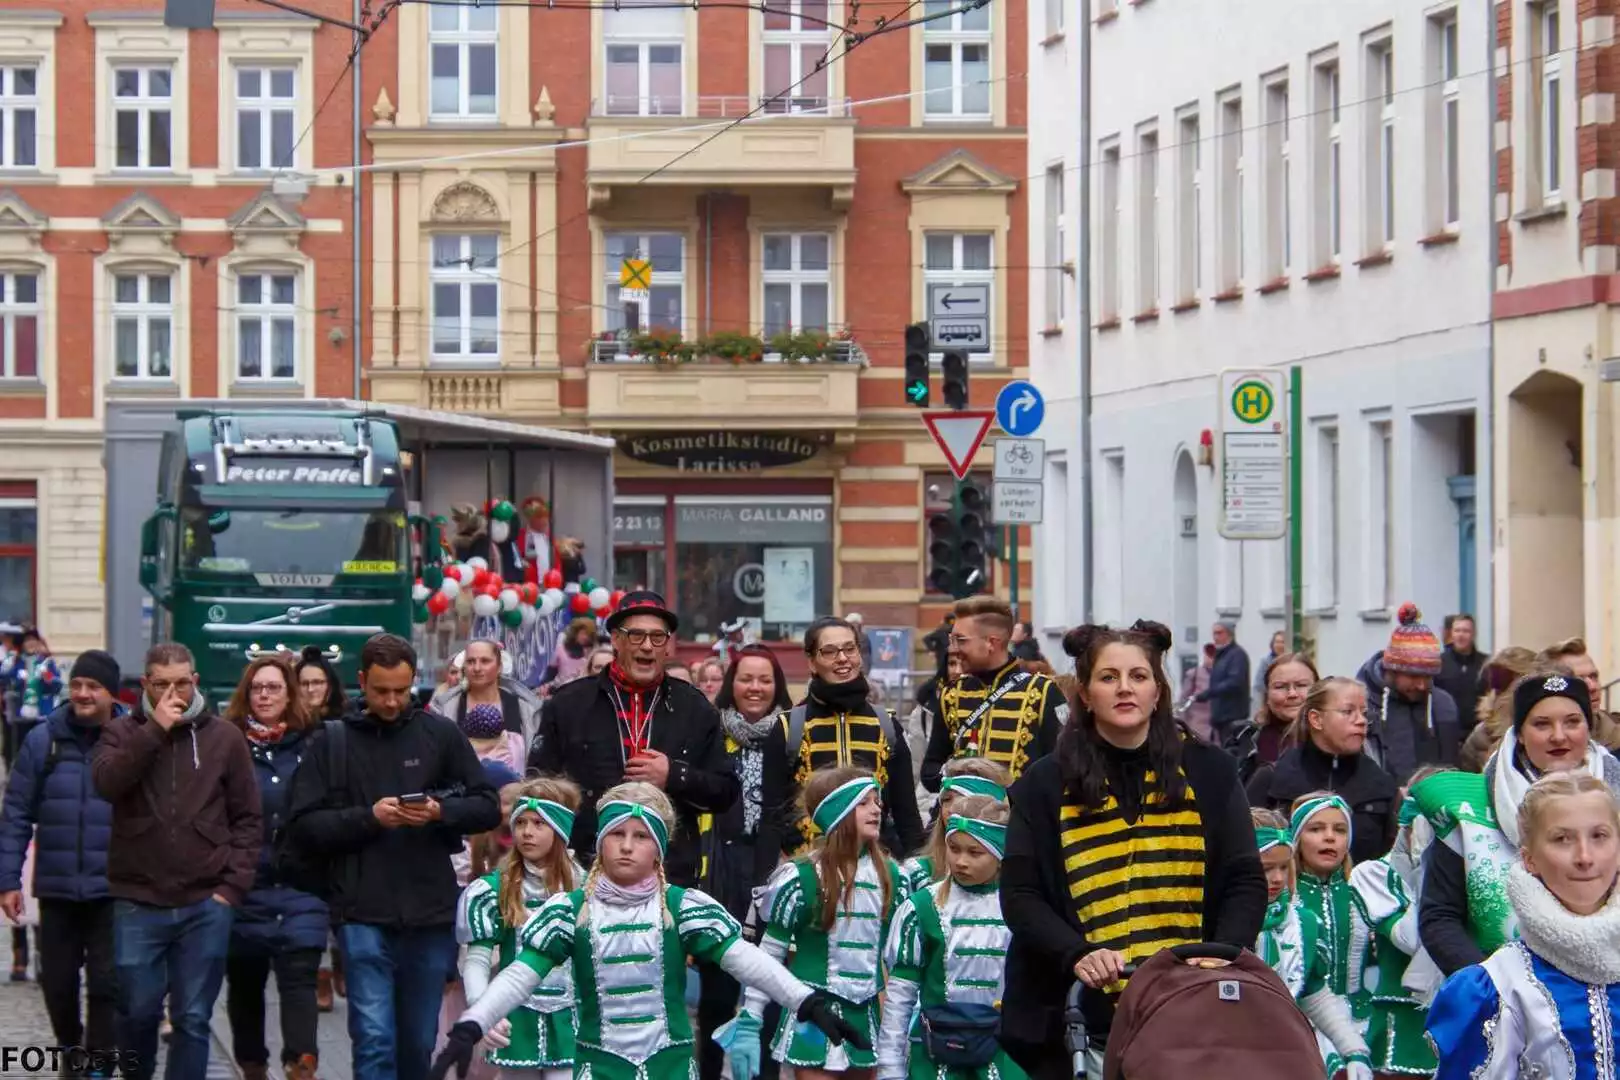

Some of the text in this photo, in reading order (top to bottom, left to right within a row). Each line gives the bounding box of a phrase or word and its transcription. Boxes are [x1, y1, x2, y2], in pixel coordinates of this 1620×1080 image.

[1242, 391, 1262, 413] H
[631, 431, 812, 456] Kosmetikstudio
[678, 455, 762, 473] Larissa
[227, 466, 361, 482] Peter Pfaffe
[626, 516, 642, 530] 23
[646, 517, 662, 530] 13
[682, 508, 826, 522] MARIA GALLAND
[269, 573, 323, 586] VOLVO
